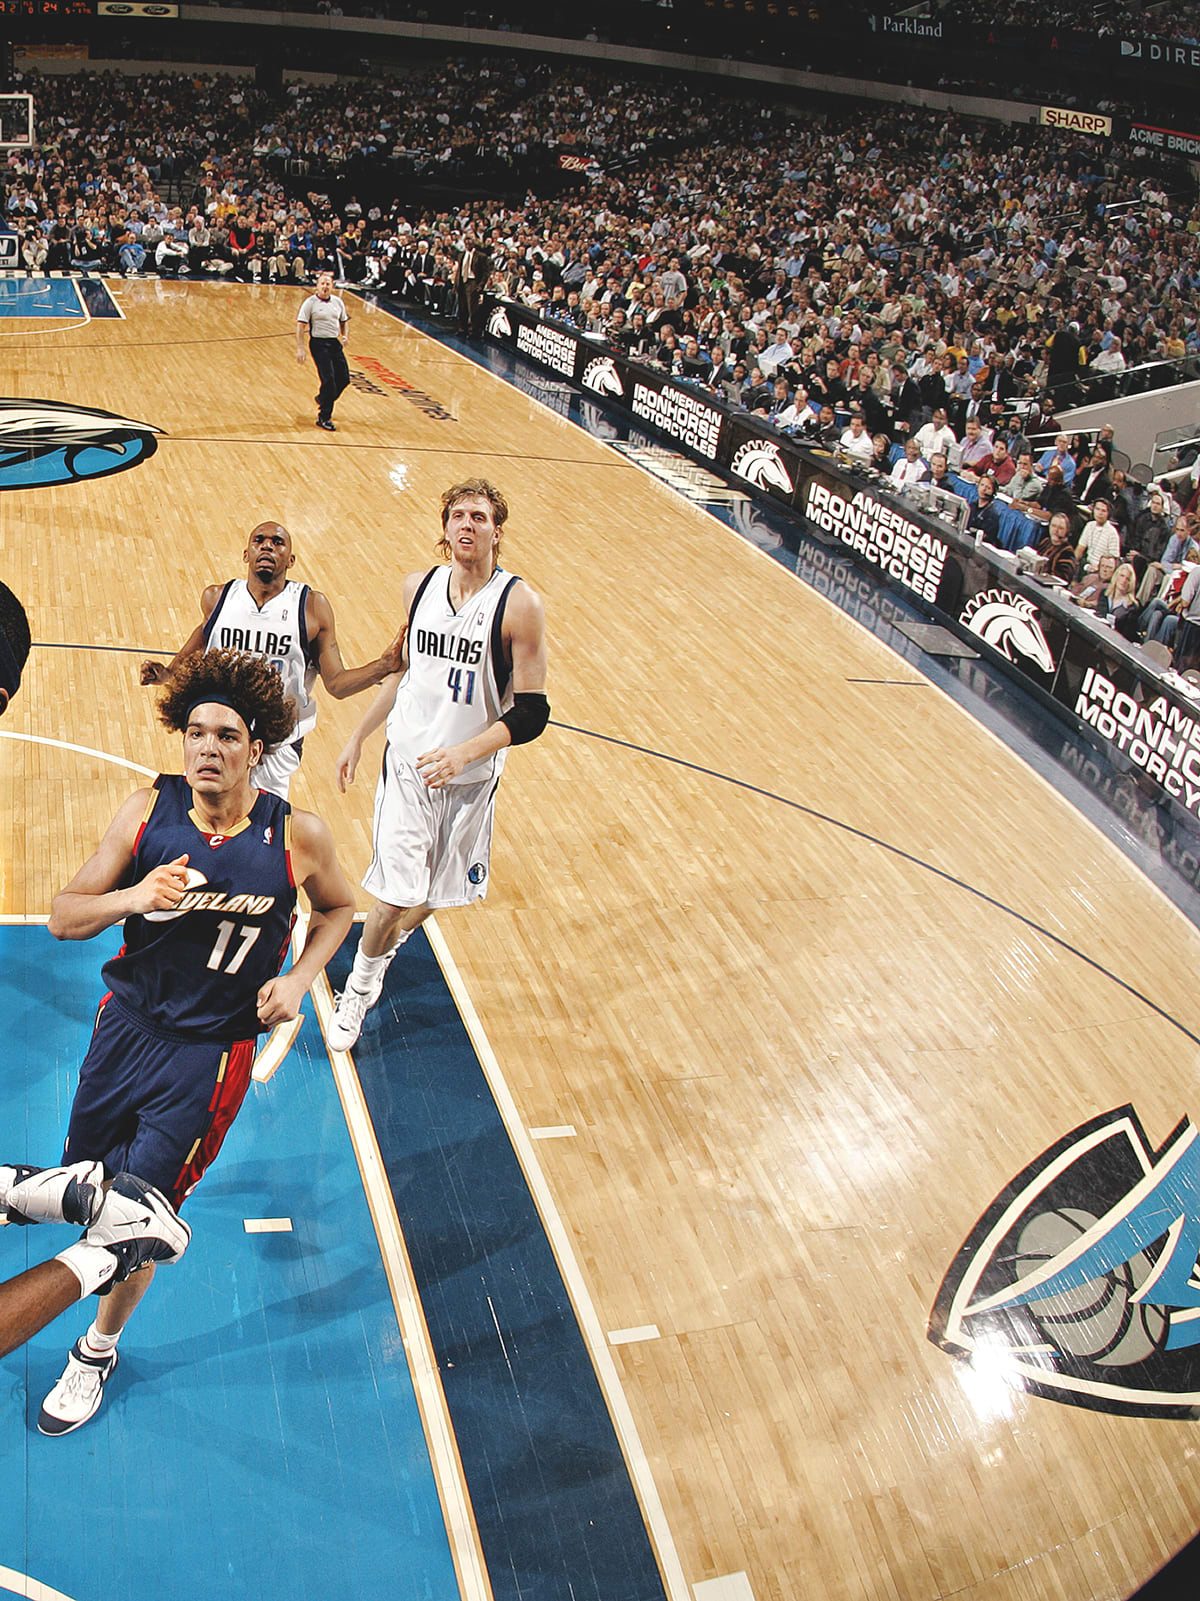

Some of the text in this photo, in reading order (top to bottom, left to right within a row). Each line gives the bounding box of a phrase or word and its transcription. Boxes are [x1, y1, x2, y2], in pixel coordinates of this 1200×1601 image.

[883, 16, 943, 38] Parkland
[1046, 110, 1106, 131] SHARP
[1129, 127, 1200, 155] ACME BRICK
[518, 324, 577, 363] IRONHORSE
[535, 323, 577, 349] AMERICAN
[516, 338, 575, 378] MOTORCYCLES
[634, 383, 721, 446] IRONHORSE
[660, 384, 723, 429] AMERICAN
[632, 404, 717, 460] MOTORCYCLES
[809, 482, 944, 586] IRONHORSE
[851, 491, 949, 563] AMERICAN
[805, 503, 938, 604] MOTORCYCLES
[220, 627, 292, 656] DALLAS
[416, 628, 484, 666] DALLAS
[446, 667, 476, 706] 41
[206, 919, 262, 975] 17
